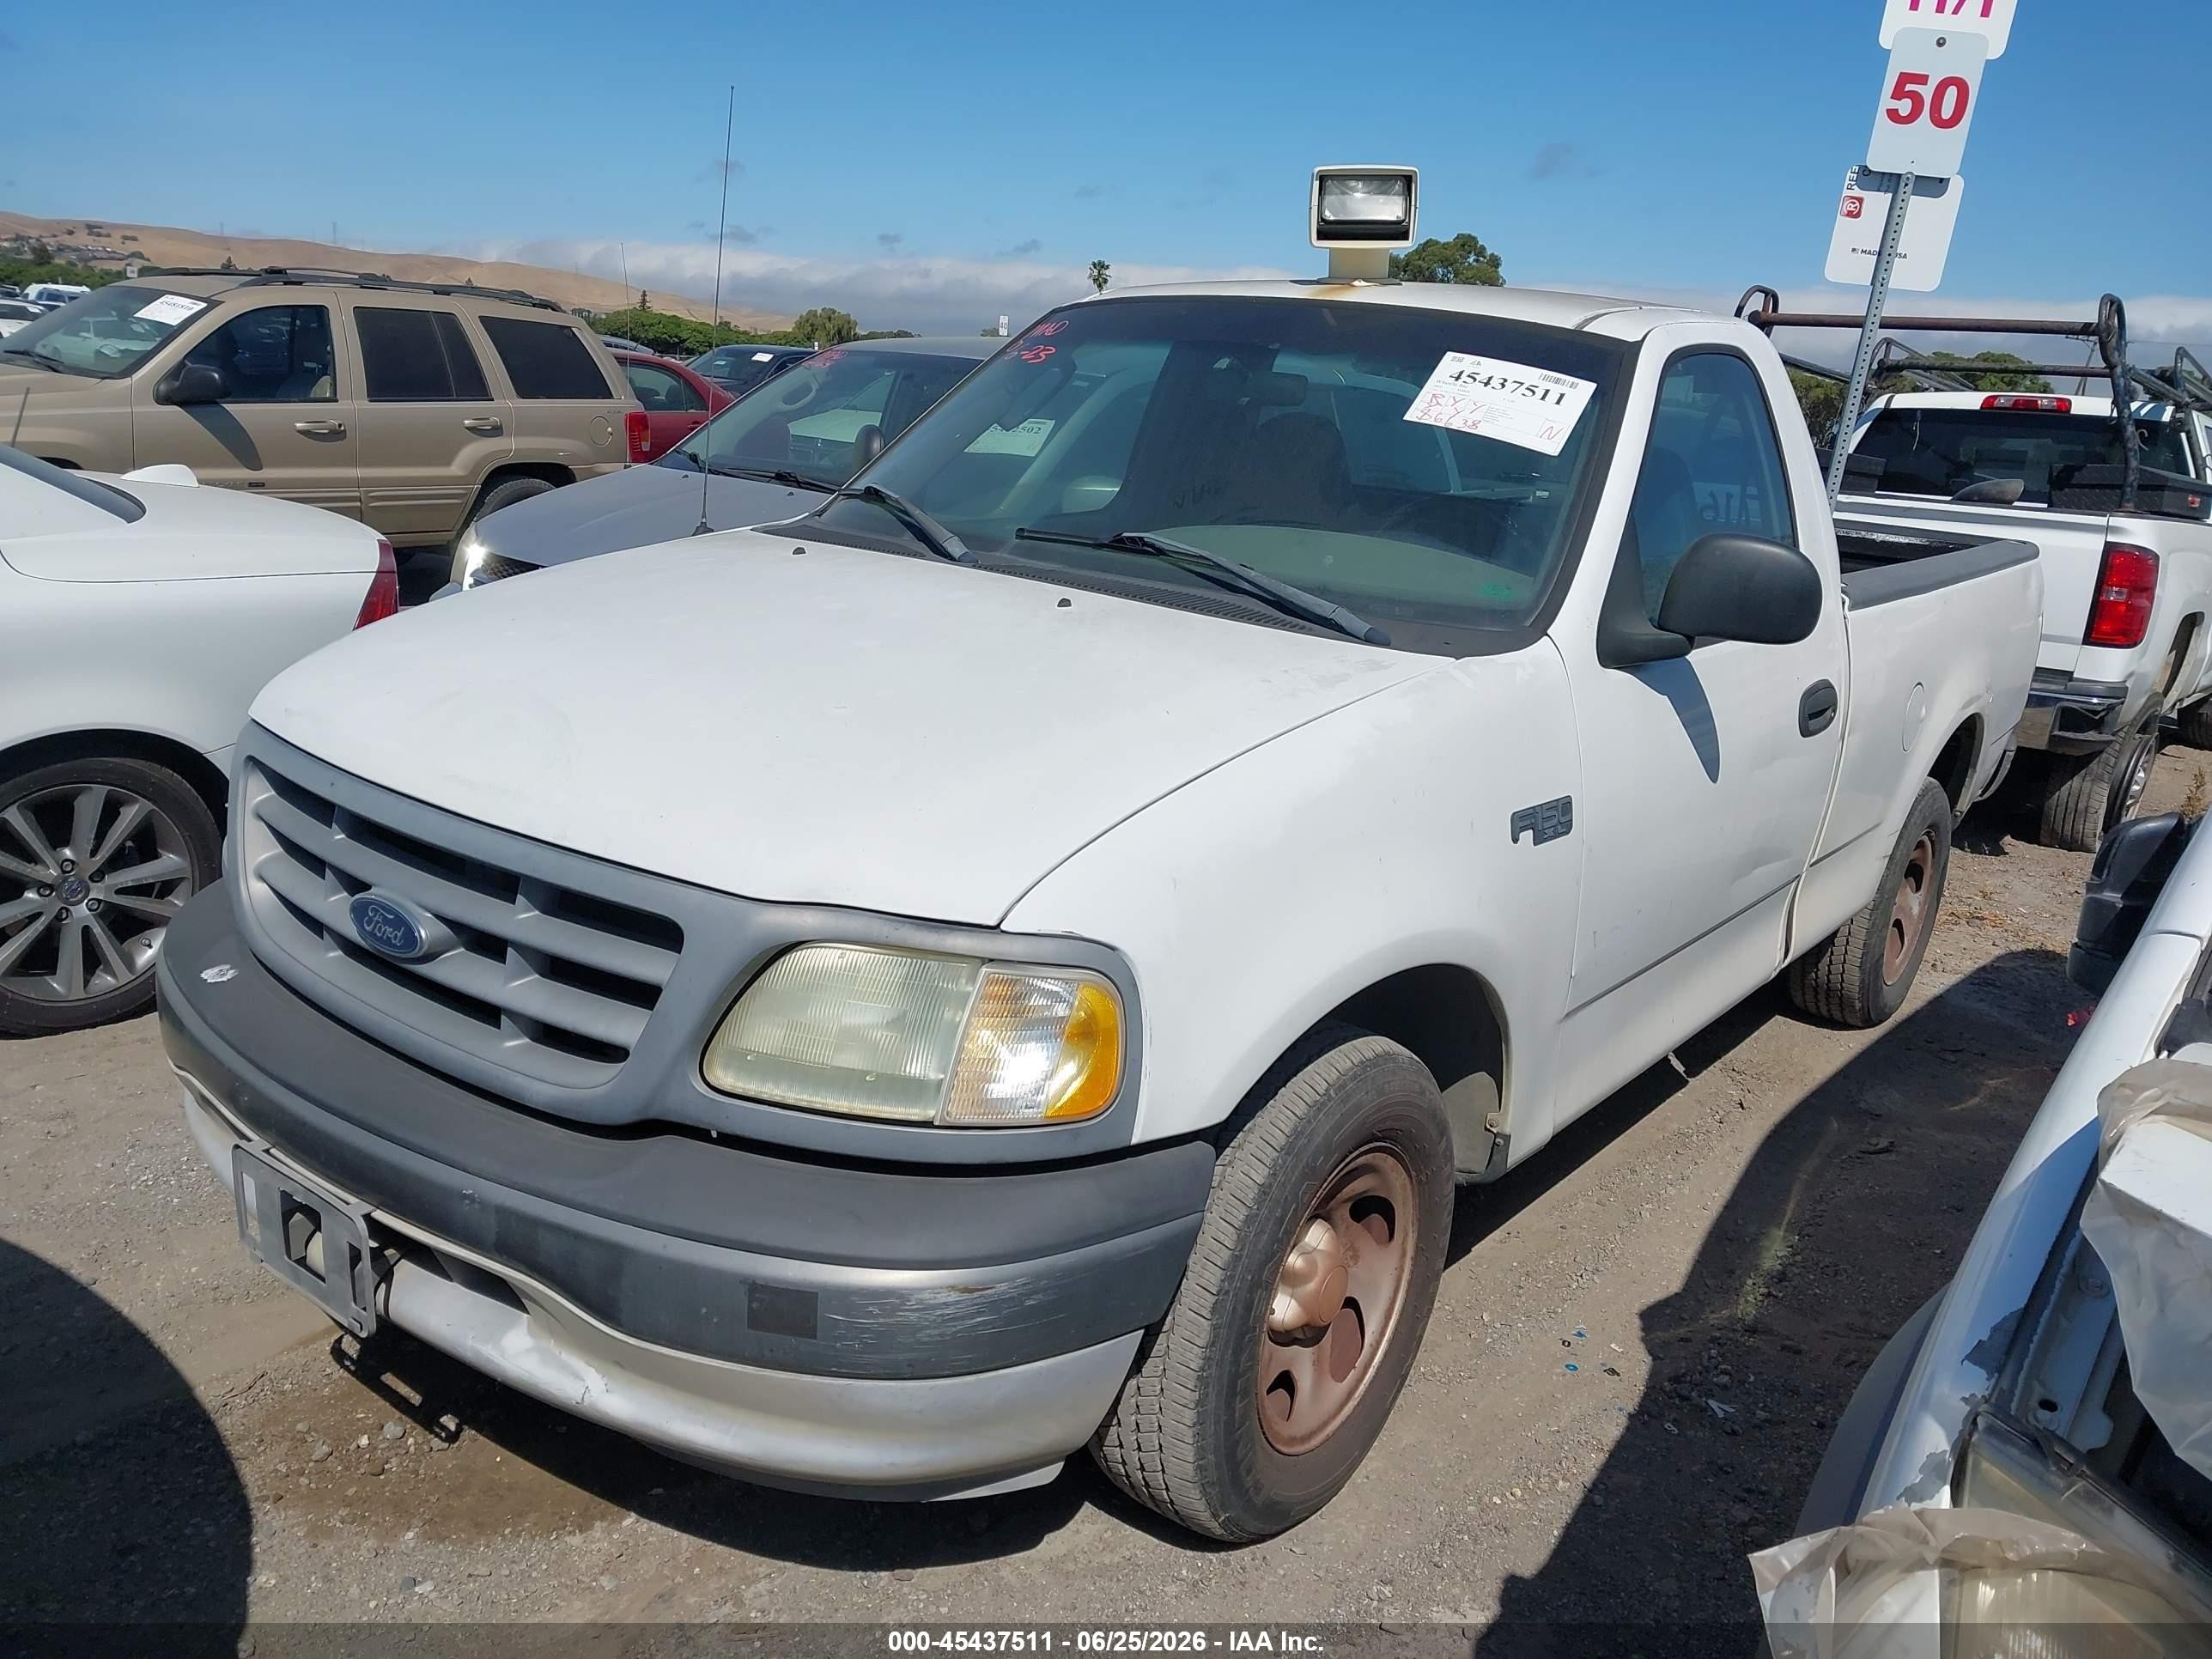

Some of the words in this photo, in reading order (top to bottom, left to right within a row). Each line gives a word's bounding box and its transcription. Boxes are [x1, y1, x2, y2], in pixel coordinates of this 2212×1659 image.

[1886, 71, 1970, 130] 50
[1449, 369, 1566, 406] 45437511
[363, 905, 406, 946] Ford
